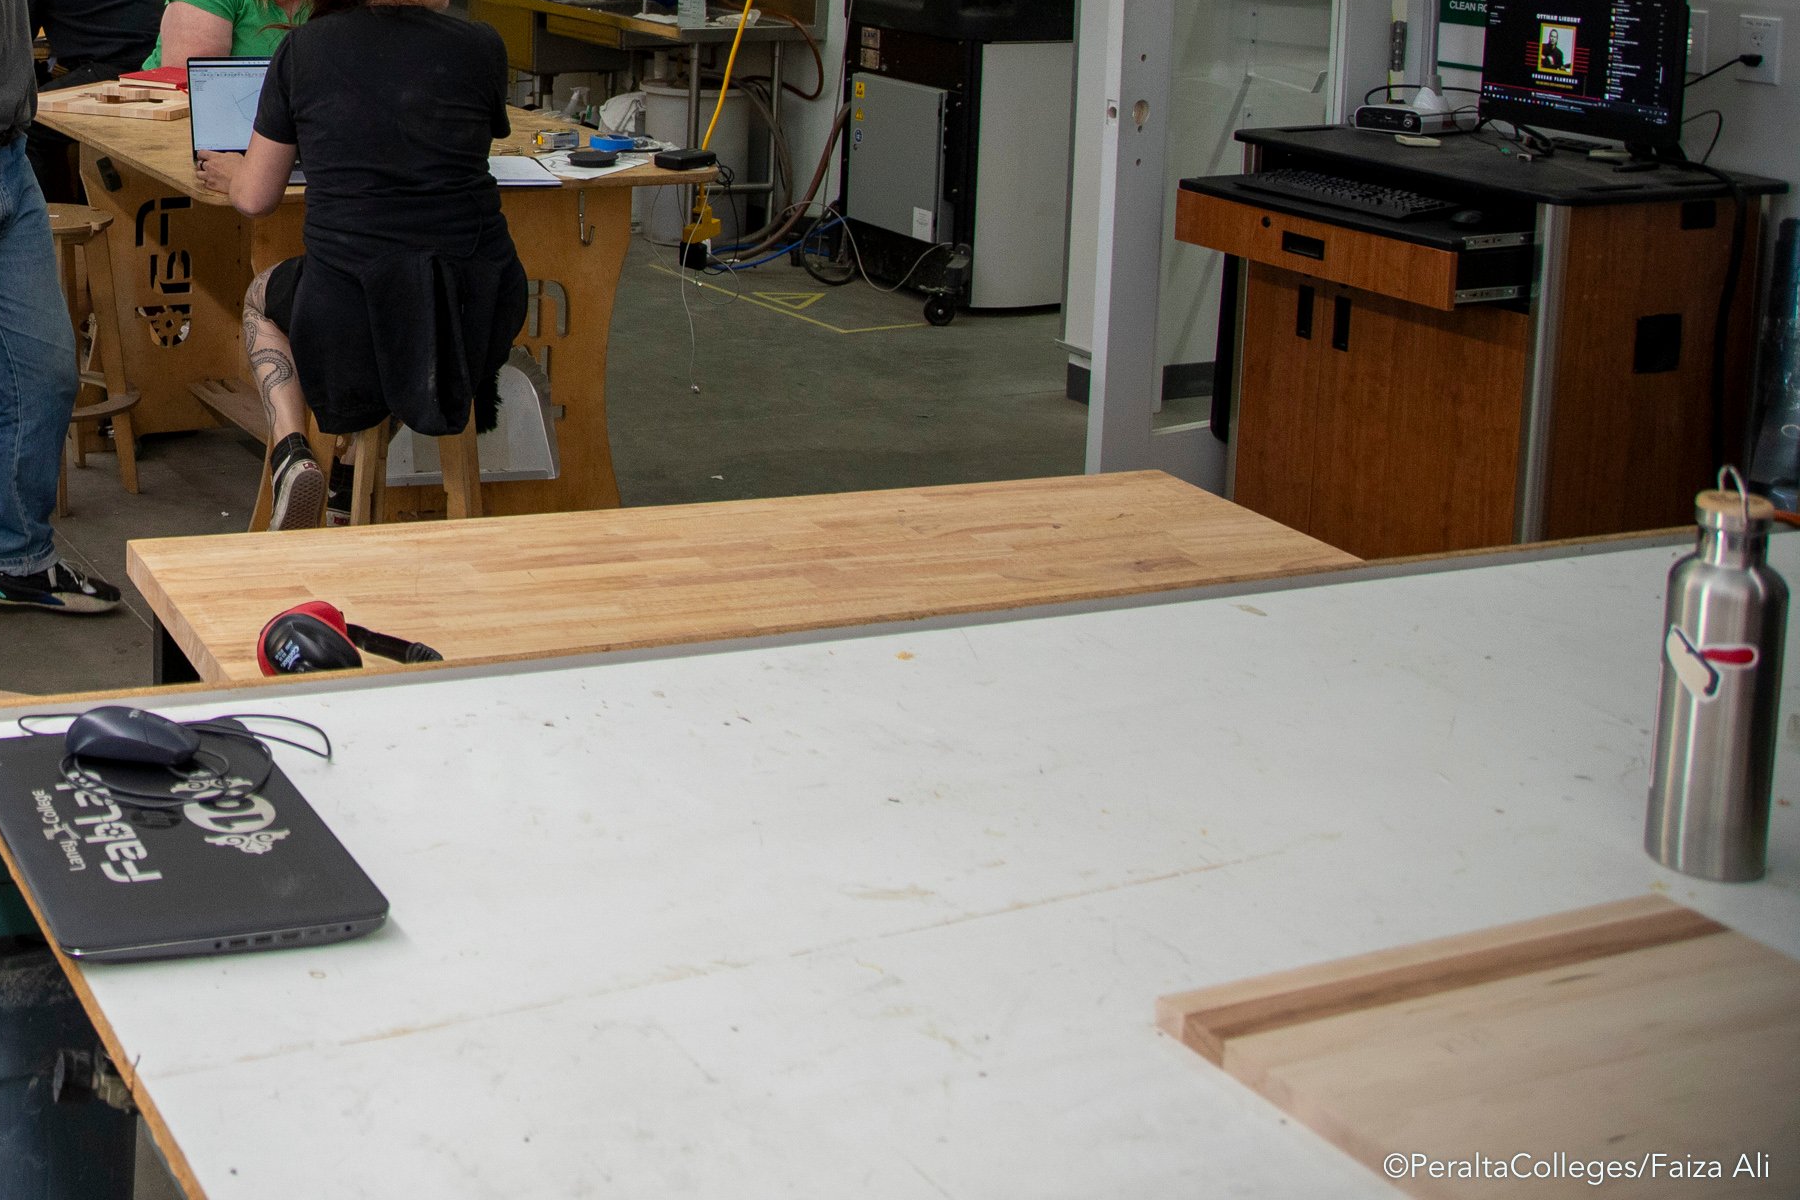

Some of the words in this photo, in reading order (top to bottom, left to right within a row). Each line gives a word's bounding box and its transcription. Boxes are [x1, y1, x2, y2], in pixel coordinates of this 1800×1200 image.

[1449, 0, 1476, 12] CLEAN
[31, 788, 61, 825] College
[59, 838, 87, 872] Laney
